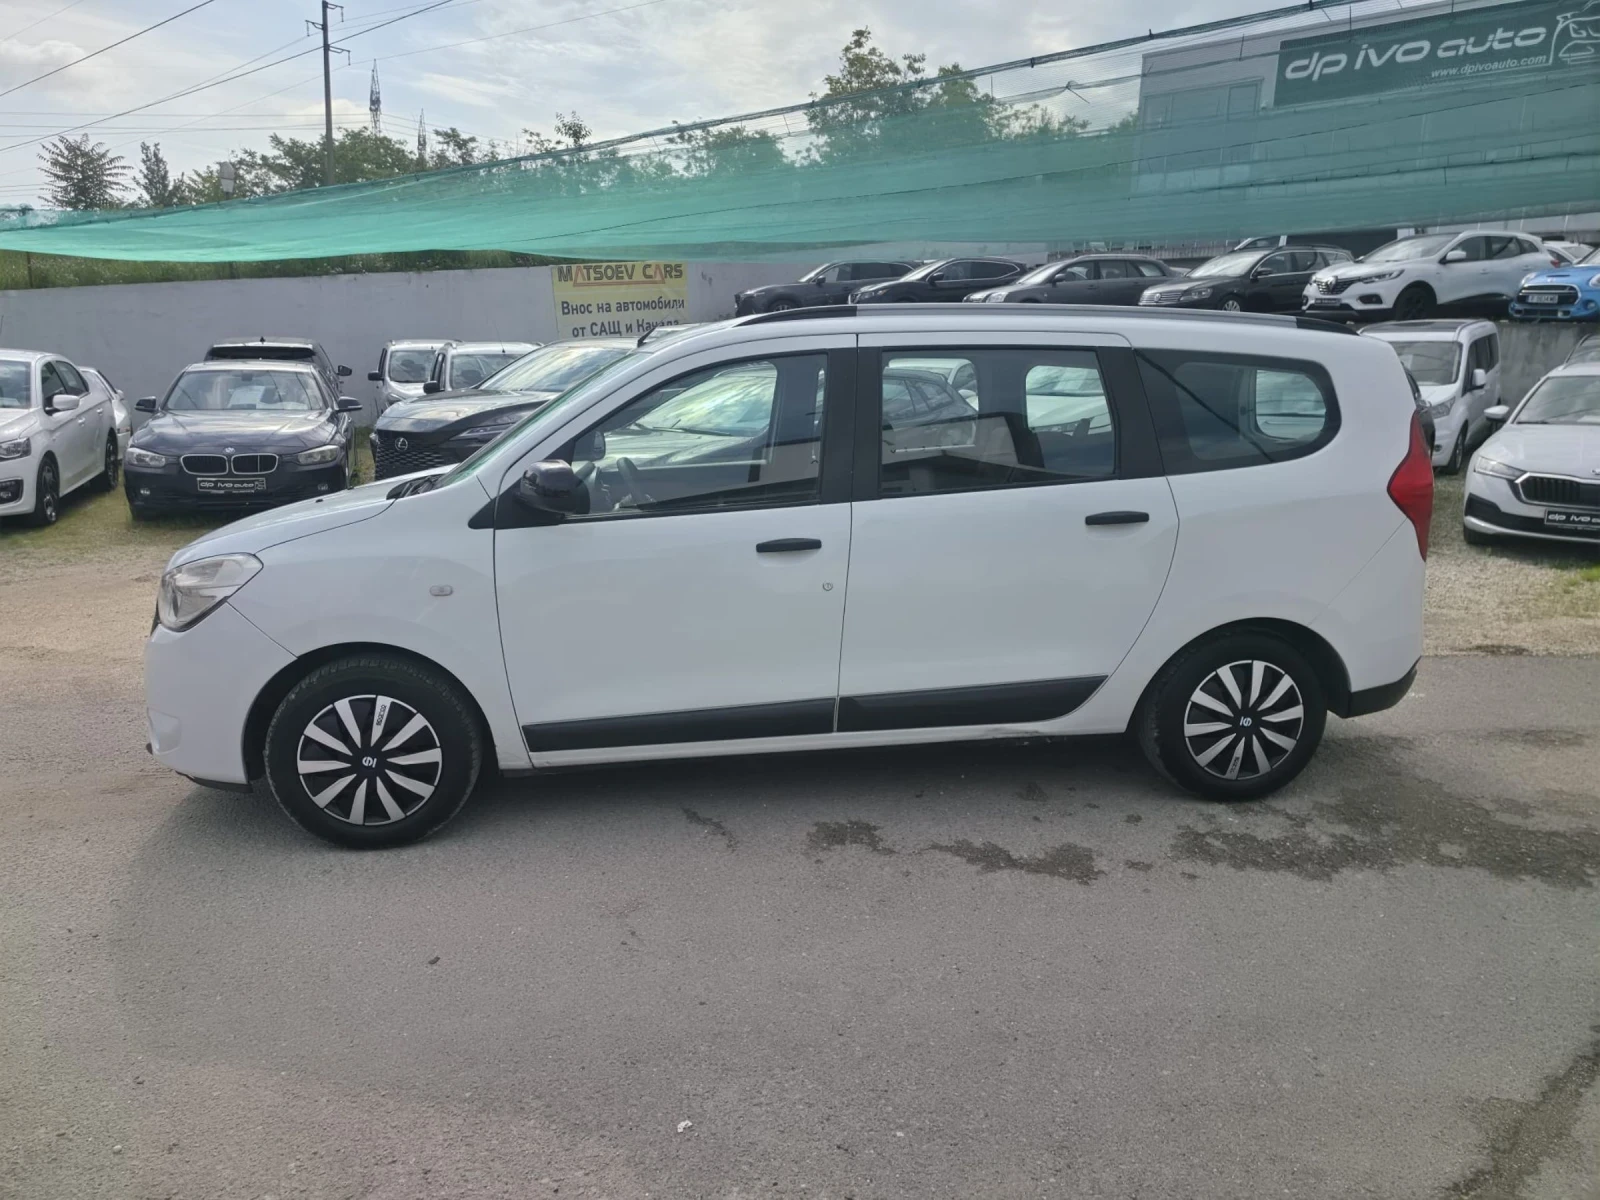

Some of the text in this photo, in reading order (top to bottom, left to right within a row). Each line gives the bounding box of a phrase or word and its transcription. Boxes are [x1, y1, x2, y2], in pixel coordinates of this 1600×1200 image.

[1285, 27, 1547, 81] dp ivo auto
[1431, 54, 1547, 78] www.dpivoauto.com
[557, 263, 683, 284] MATSOEV CARS
[561, 296, 685, 315] Внос на автомобили
[572, 327, 586, 337] от
[590, 320, 622, 336] САЩ
[626, 323, 633, 333] и
